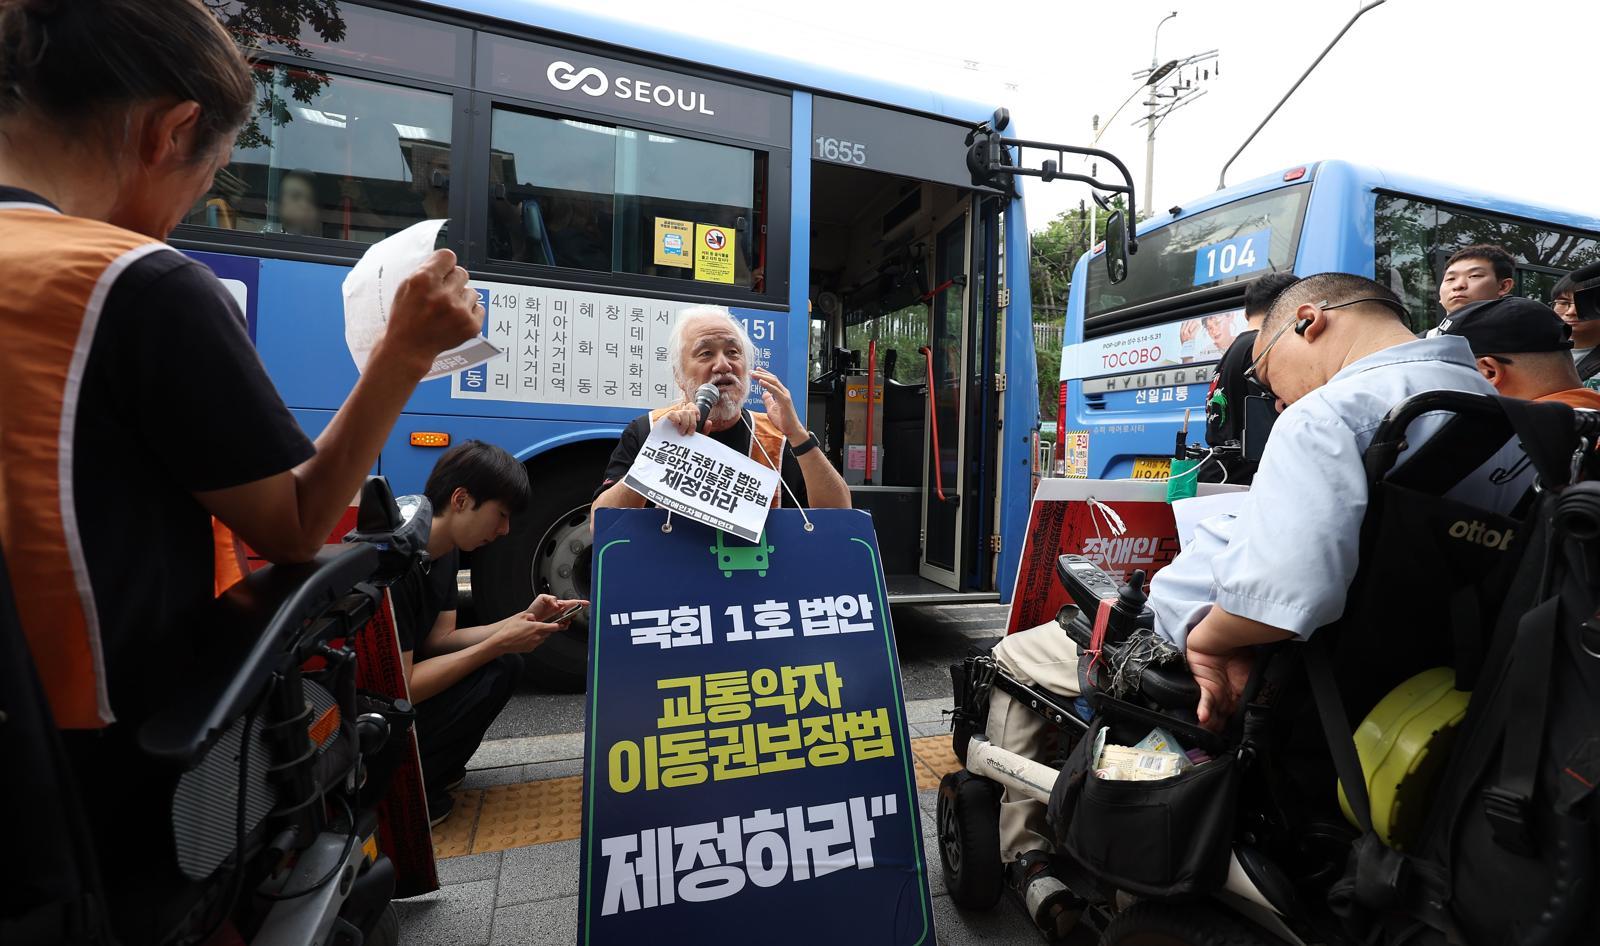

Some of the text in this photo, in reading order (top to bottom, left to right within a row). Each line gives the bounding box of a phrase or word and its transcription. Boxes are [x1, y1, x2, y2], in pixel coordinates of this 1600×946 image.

[614, 77, 715, 116] SEOUL
[815, 136, 867, 165] 1655
[1207, 238, 1256, 277] 104
[523, 296, 542, 391] 화계사사거리
[551, 299, 568, 392] 미아사거리역
[577, 301, 595, 394] 혜화동
[602, 304, 620, 397] 창덕궁
[628, 307, 646, 397] 롯데백화점
[654, 309, 671, 399] 서울역
[741, 318, 775, 341] 151
[754, 347, 772, 359] 이동
[1102, 346, 1162, 369] TOCOBO
[1106, 368, 1208, 390] HYUNDA
[1135, 386, 1189, 405] 선일교통
[641, 446, 769, 508] 교통약자 이동권 보장법
[658, 440, 762, 492] 22대 국회 1호 법안
[659, 468, 739, 514] 제정하라
[610, 594, 874, 649] "국회 1호 법안
[656, 661, 843, 729] 교통약자
[608, 707, 895, 794] 이동권보장법
[601, 793, 898, 917] 제정하라"
